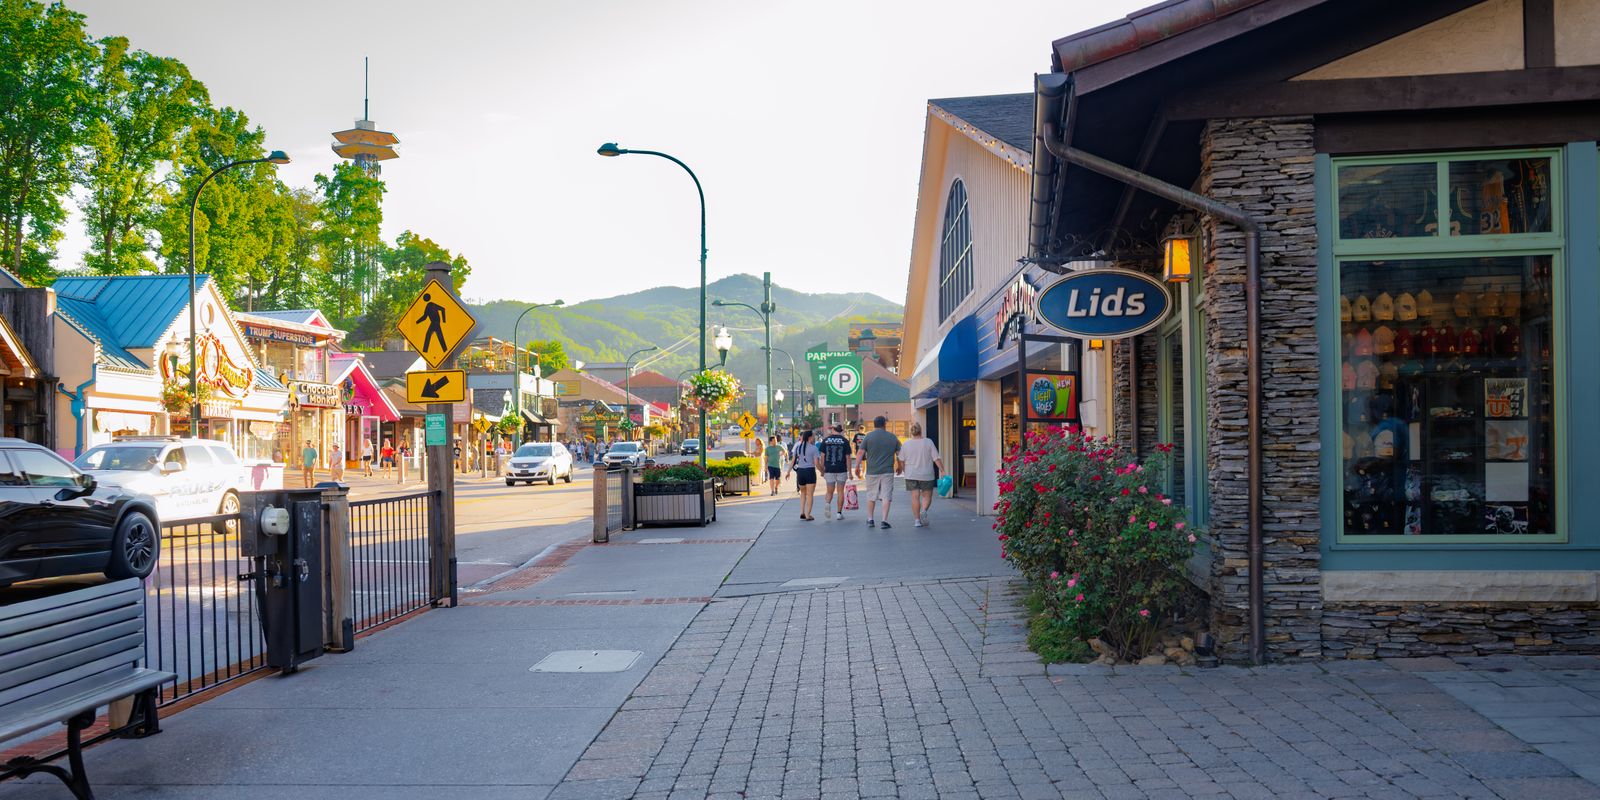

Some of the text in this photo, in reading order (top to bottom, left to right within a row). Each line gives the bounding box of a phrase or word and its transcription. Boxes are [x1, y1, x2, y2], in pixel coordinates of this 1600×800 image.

[1067, 287, 1146, 317] Lids
[249, 326, 313, 344] TRUMP SUPERSTORE
[838, 372, 852, 389] P
[1056, 379, 1072, 389] NEW
[309, 393, 339, 406] Monkey
[1033, 389, 1053, 402] LIGHT
[1035, 400, 1054, 414] HOLES
